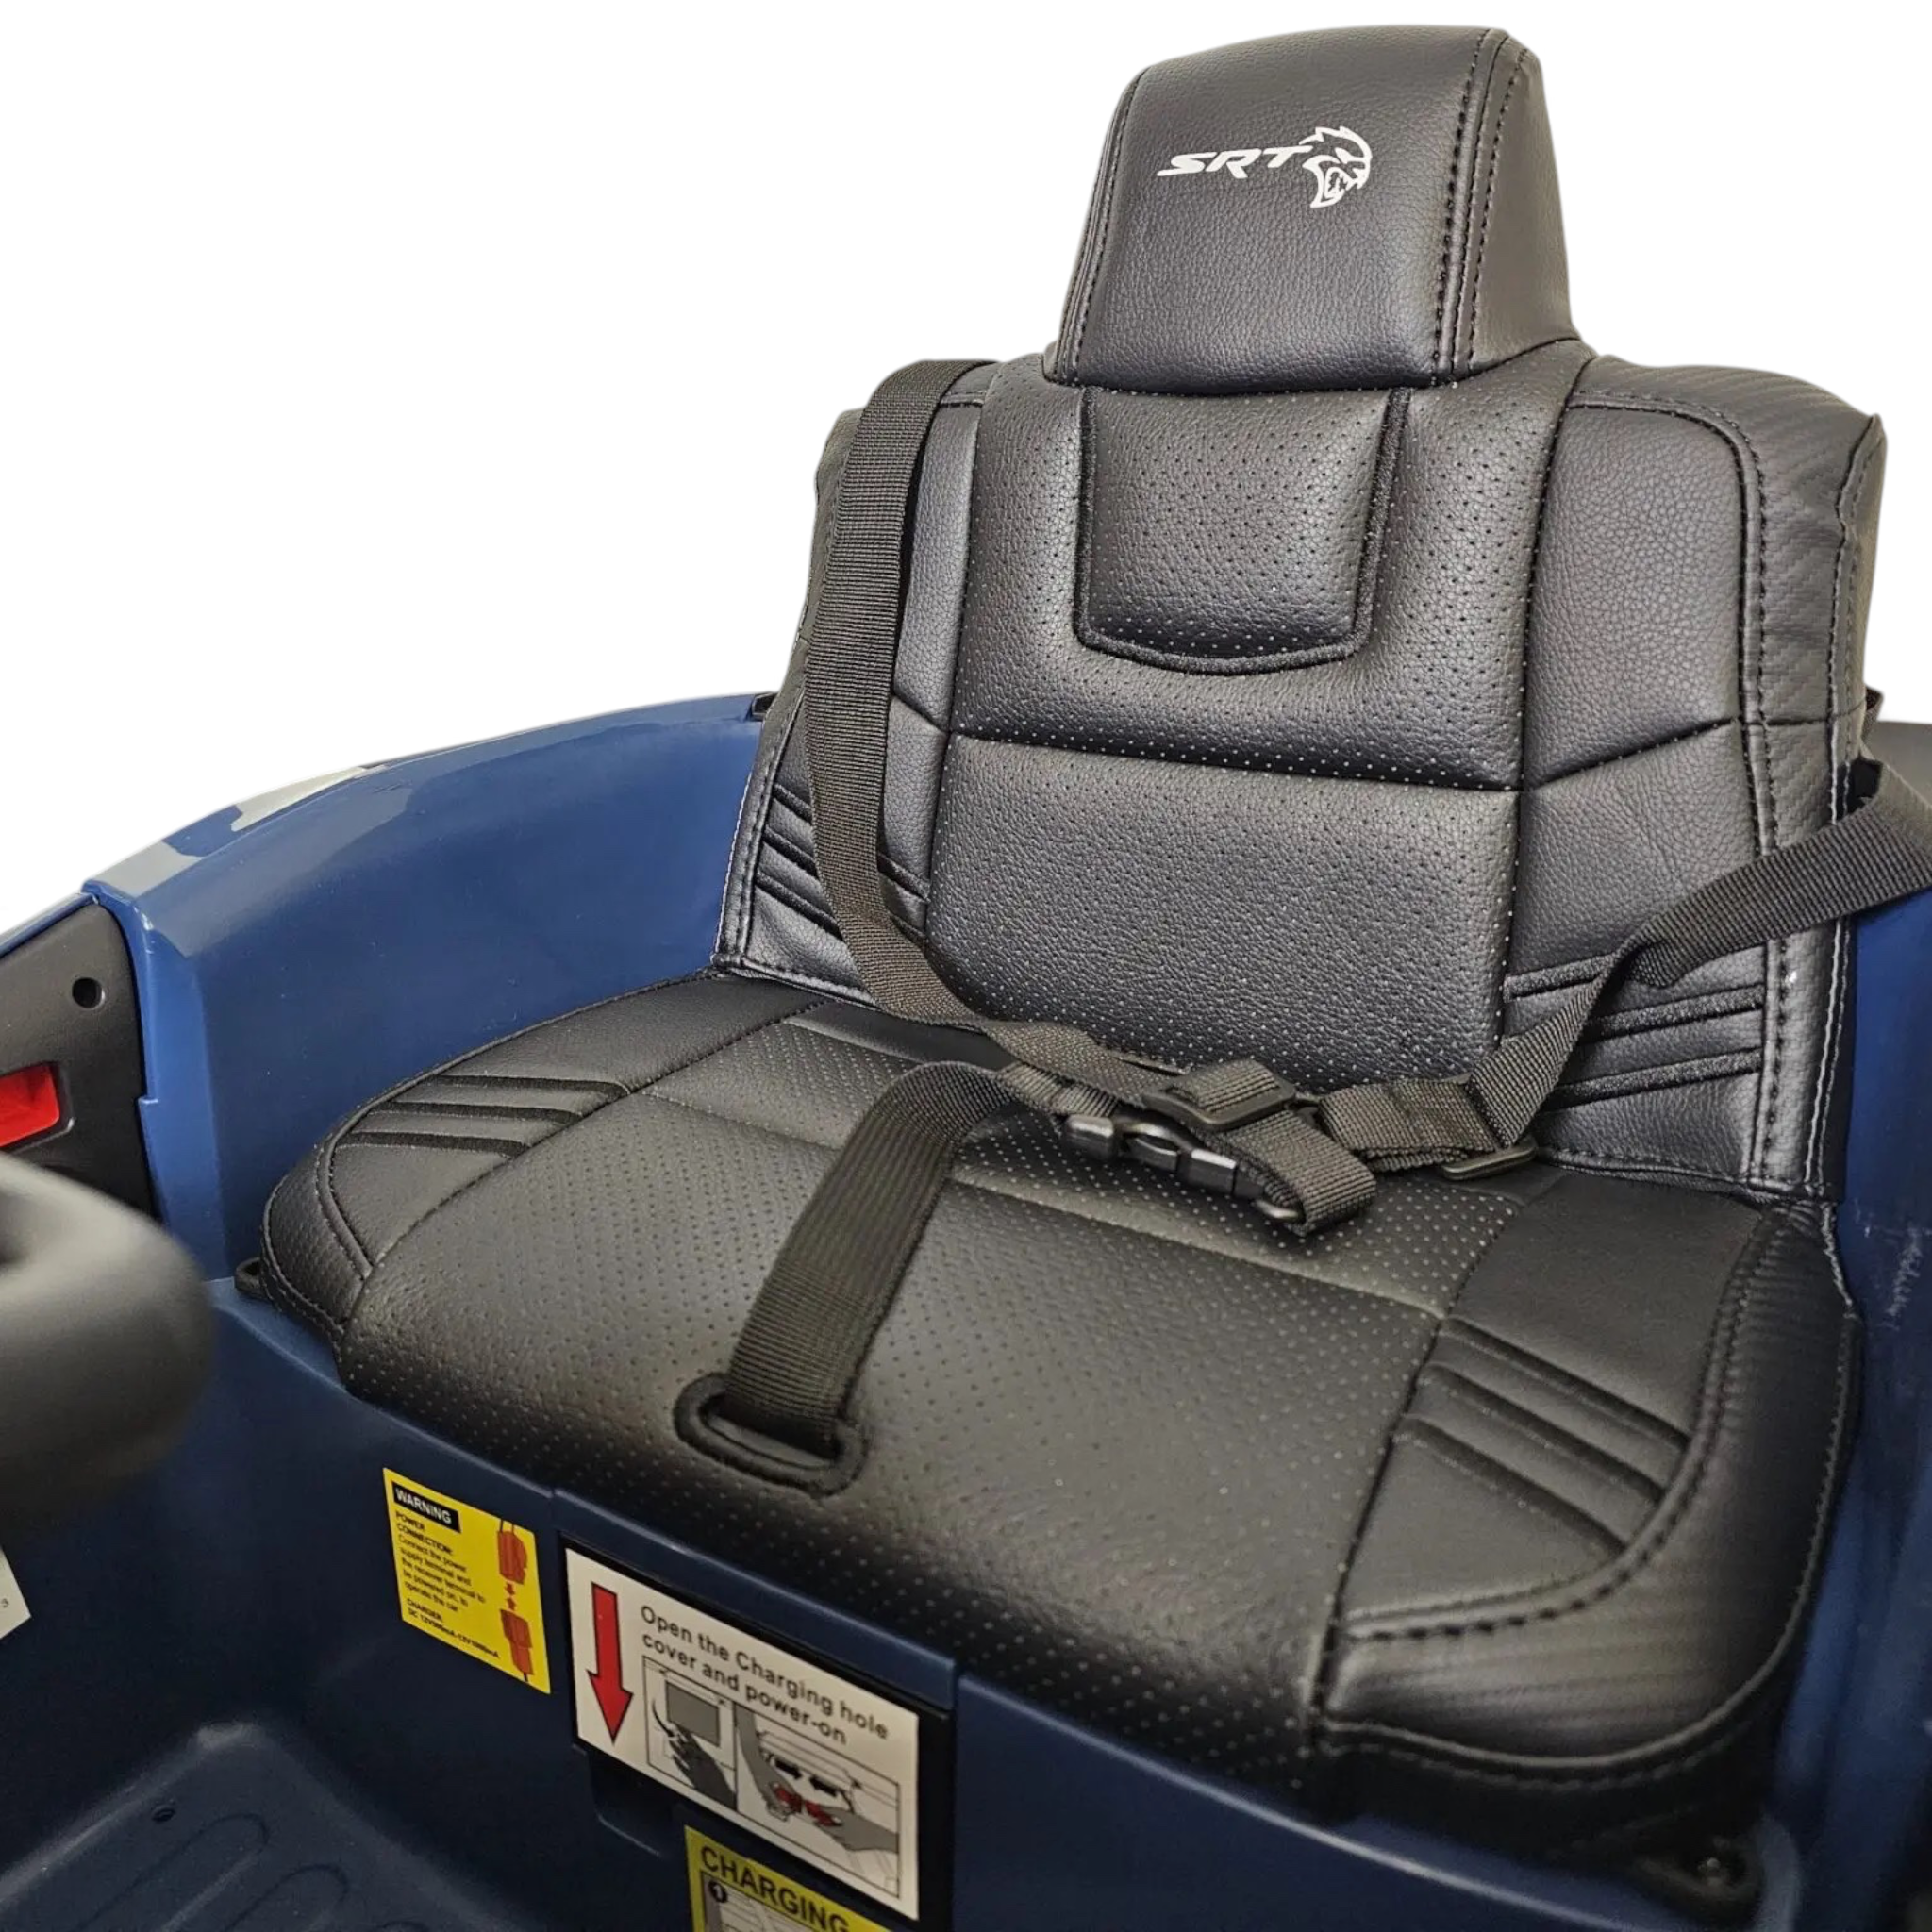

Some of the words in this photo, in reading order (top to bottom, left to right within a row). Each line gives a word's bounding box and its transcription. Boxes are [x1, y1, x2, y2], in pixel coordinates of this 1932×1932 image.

[1157, 145, 1314, 179] SRT
[395, 1488, 452, 1524] WARNING
[396, 1512, 425, 1530] POWER
[641, 1606, 692, 1643] Open
[698, 1632, 730, 1662] the
[736, 1651, 835, 1715] Charging
[840, 1701, 888, 1740] hole
[642, 1635, 696, 1669] cover
[703, 1661, 740, 1691] and
[745, 1684, 846, 1744] power-on
[701, 1846, 849, 1932] CHARGING
